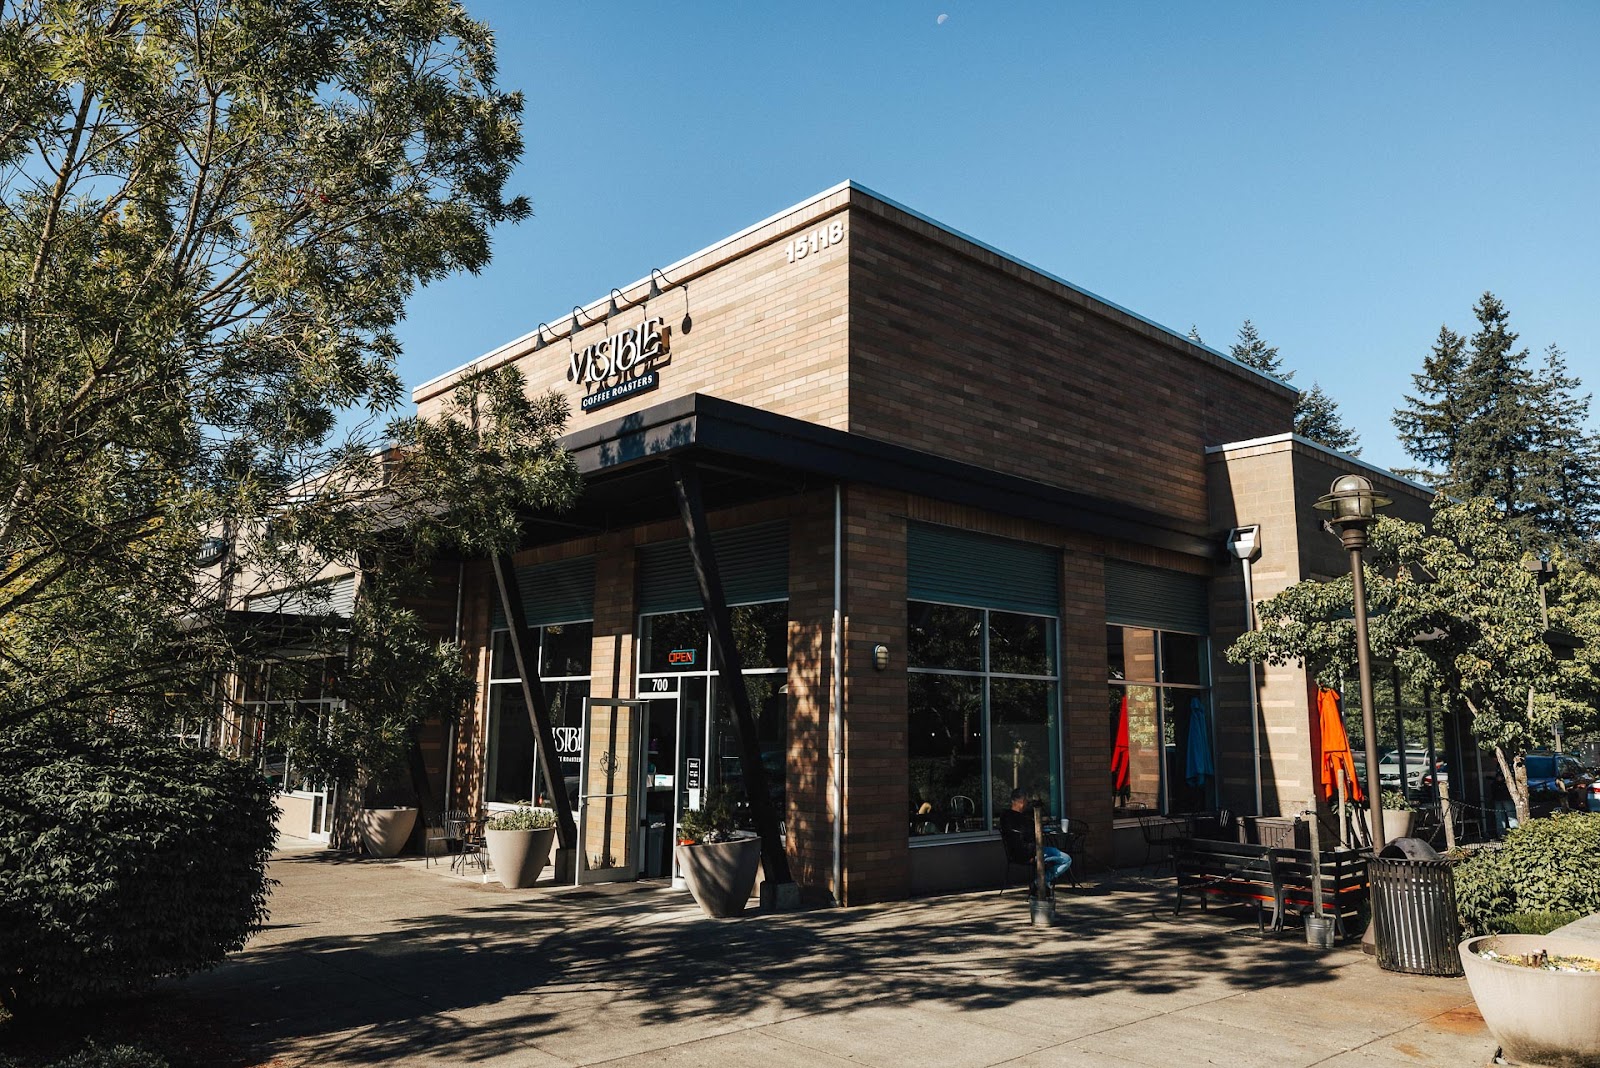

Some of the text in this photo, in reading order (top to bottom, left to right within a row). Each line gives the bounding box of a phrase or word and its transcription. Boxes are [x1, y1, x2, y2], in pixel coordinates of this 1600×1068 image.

[785, 220, 844, 263] 15118
[570, 317, 662, 382] VISIBLE
[583, 375, 653, 407] COFFEE ROASTERS
[668, 652, 693, 663] OPEN
[652, 678, 668, 691] 700
